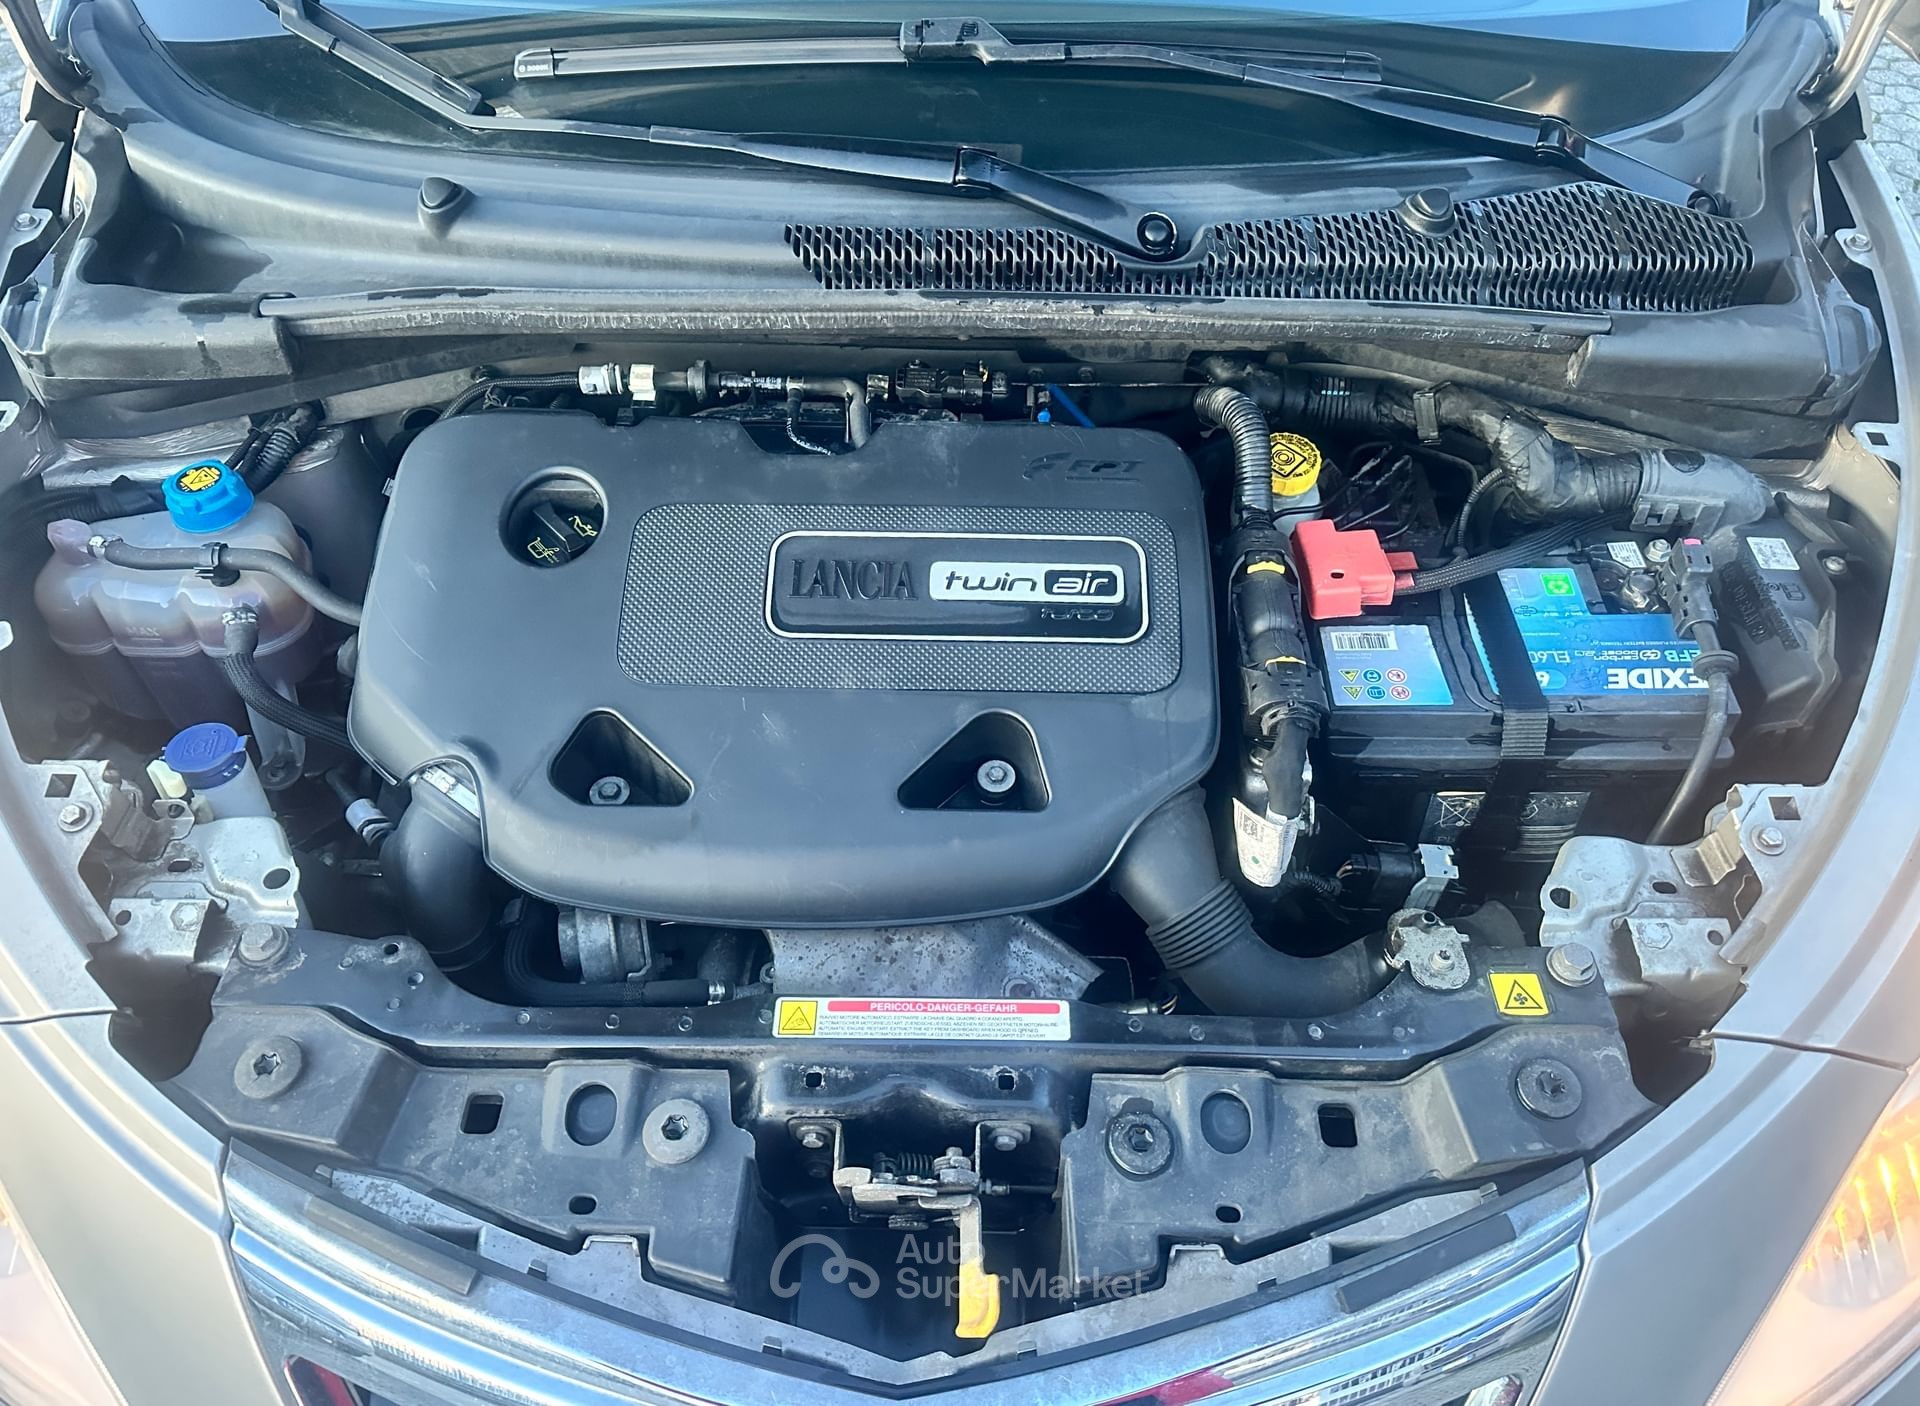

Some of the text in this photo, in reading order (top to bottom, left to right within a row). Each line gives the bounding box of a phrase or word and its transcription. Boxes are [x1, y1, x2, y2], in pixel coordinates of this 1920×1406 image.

[787, 559, 1109, 600] LANCIA twin air
[1606, 667, 1710, 689] EXIDE
[869, 1002, 1018, 1013] PERICOLO-DANGER-GEFAHR
